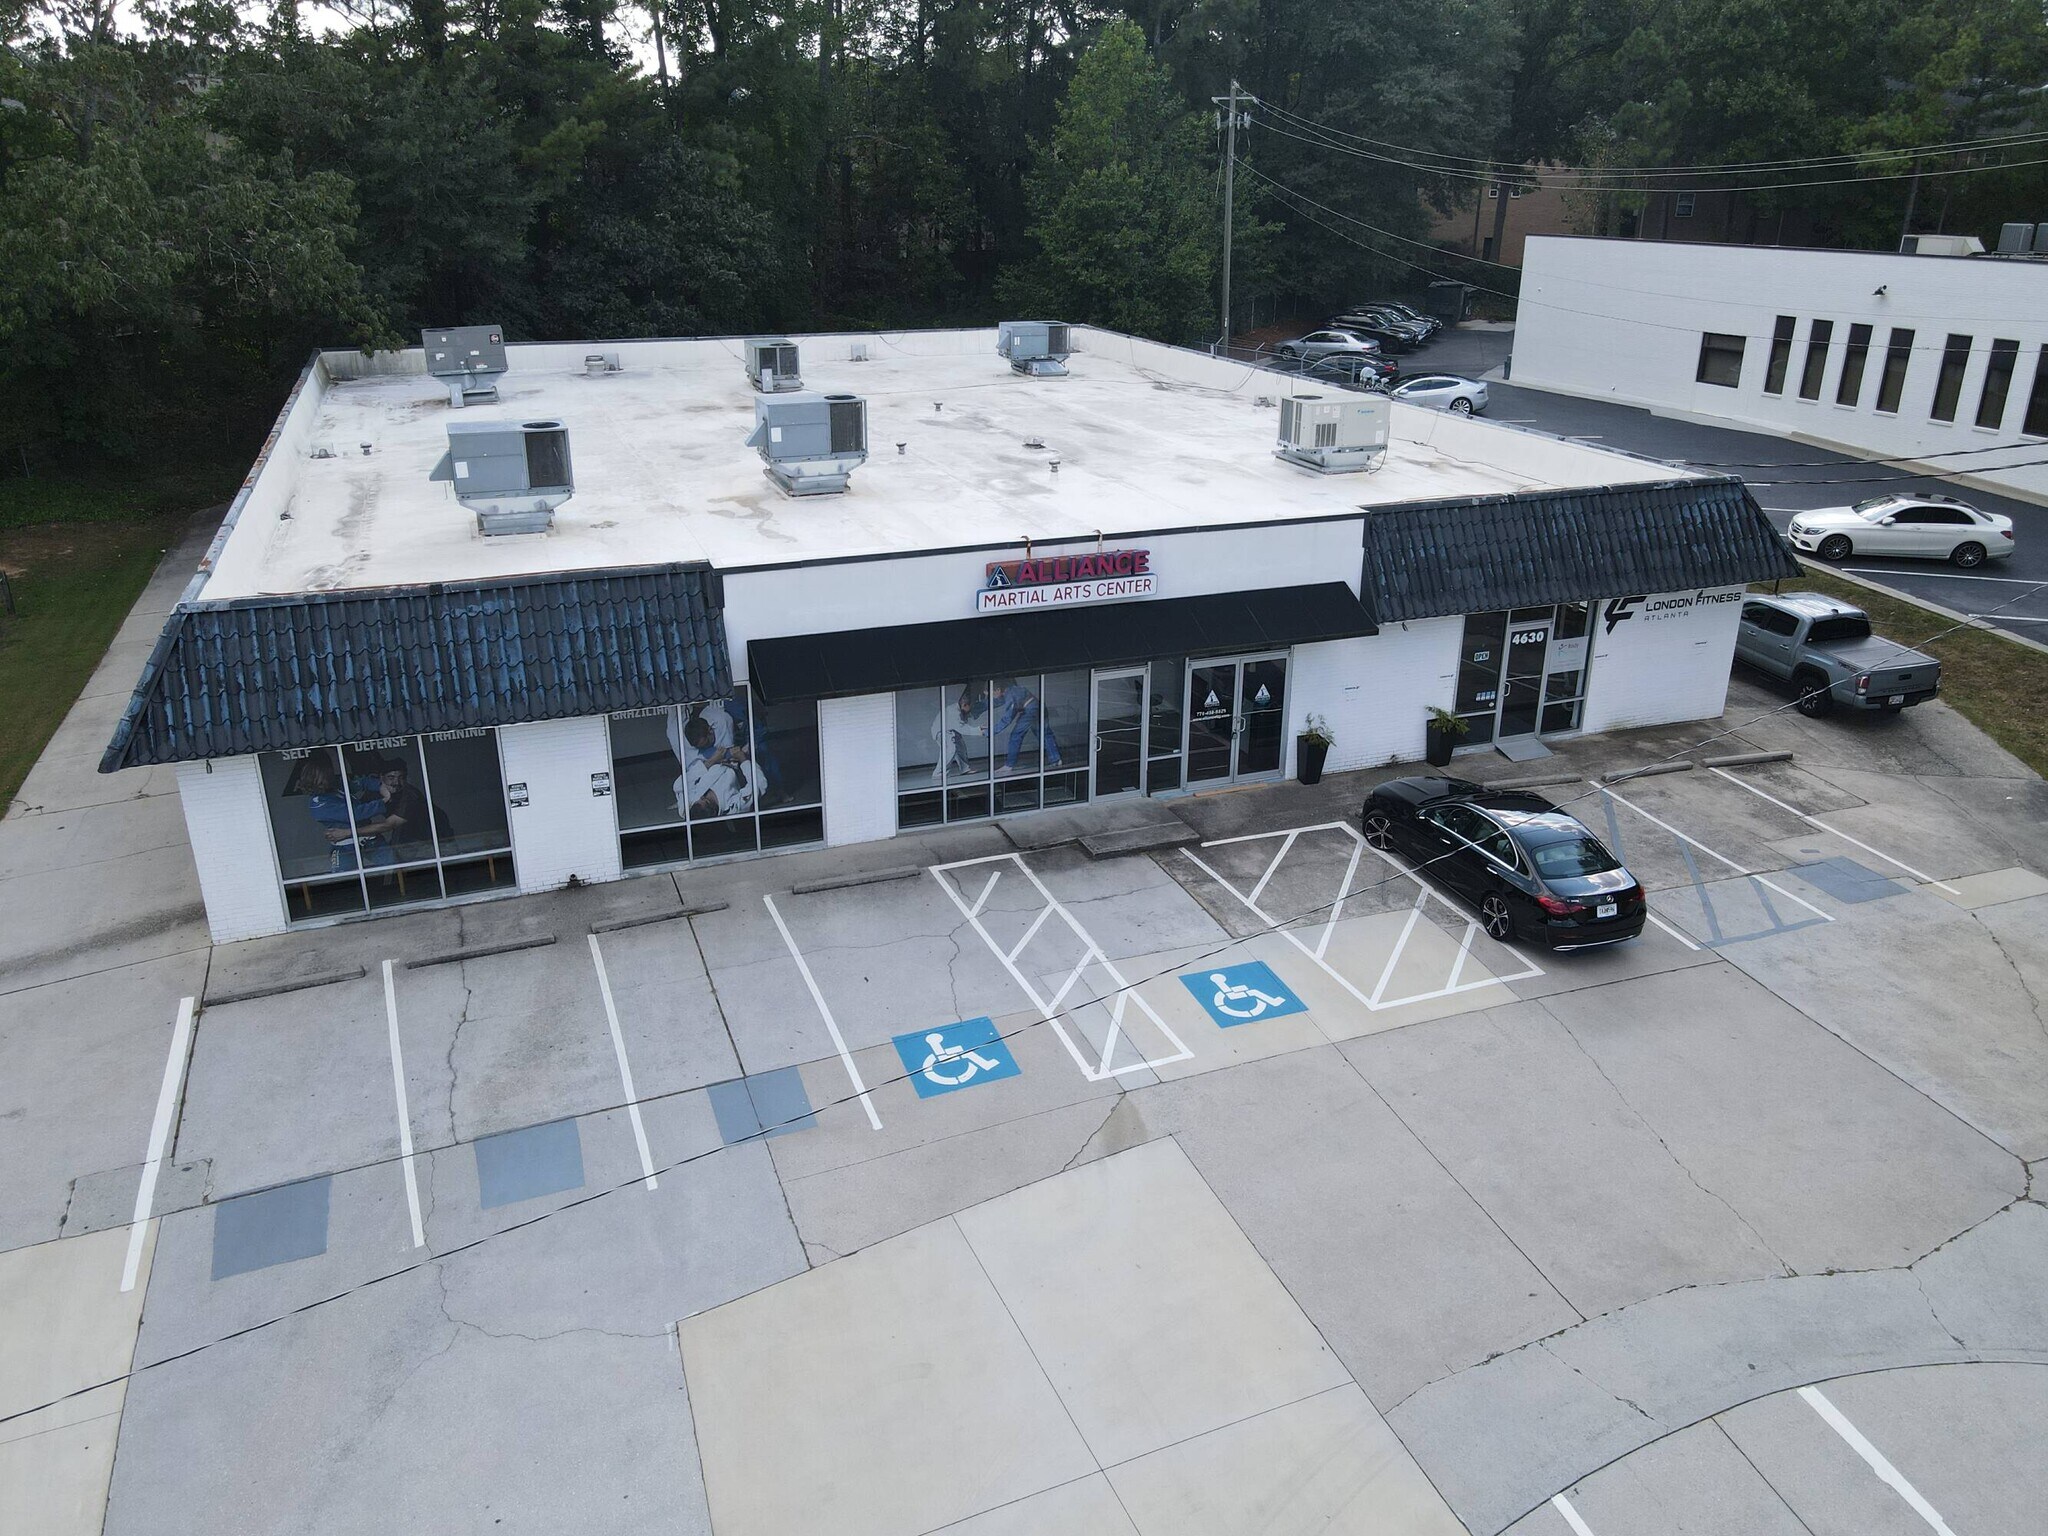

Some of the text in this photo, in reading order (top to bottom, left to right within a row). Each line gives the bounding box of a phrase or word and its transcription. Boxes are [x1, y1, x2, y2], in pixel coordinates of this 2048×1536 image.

[1016, 550, 1150, 585] ALLIANCE
[984, 578, 1152, 608] MARTIAL ARTS CENTER
[1645, 590, 1742, 612] LONDON FITNESS
[1644, 611, 1689, 621] ATLANTA
[1512, 631, 1544, 645] 4630
[282, 728, 486, 761] SELF DEFENSE TRAINING
